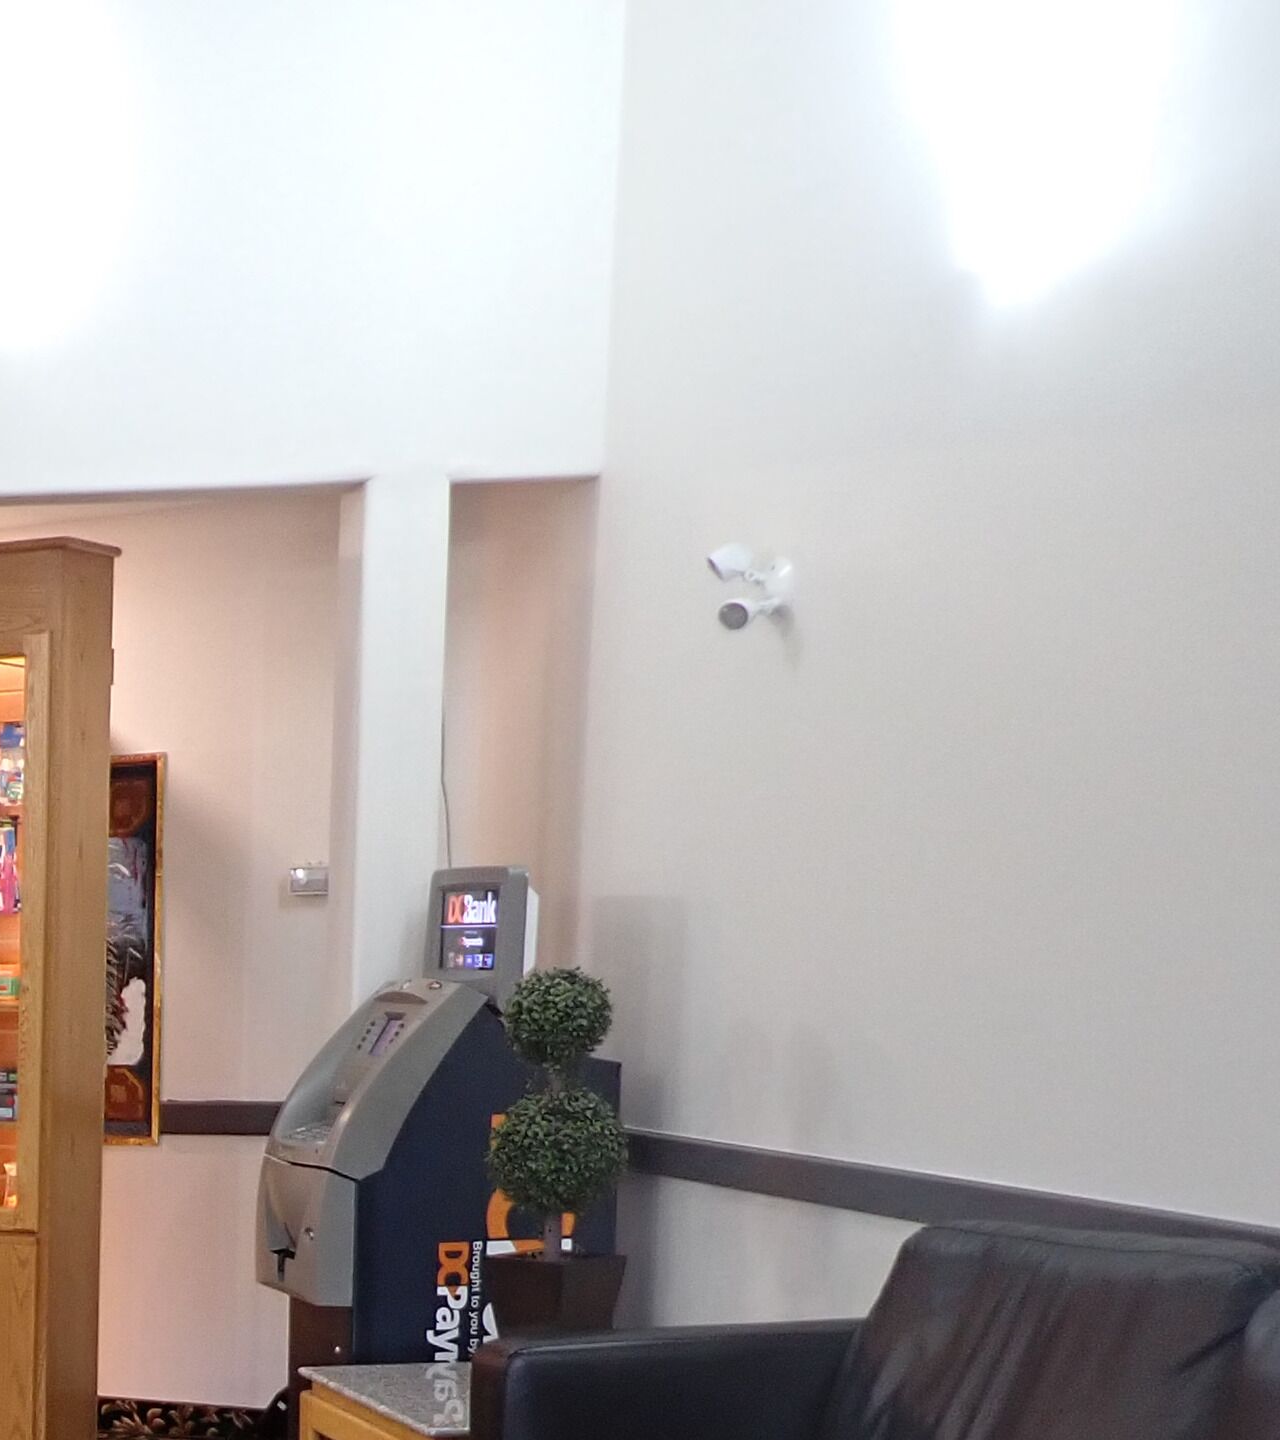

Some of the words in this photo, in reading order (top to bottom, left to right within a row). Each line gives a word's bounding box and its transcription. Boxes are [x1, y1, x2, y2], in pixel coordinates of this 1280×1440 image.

[448, 891, 496, 924] DCBank
[470, 1241, 482, 1294] Brought
[471, 1295, 480, 1308] to
[469, 1311, 480, 1335] you
